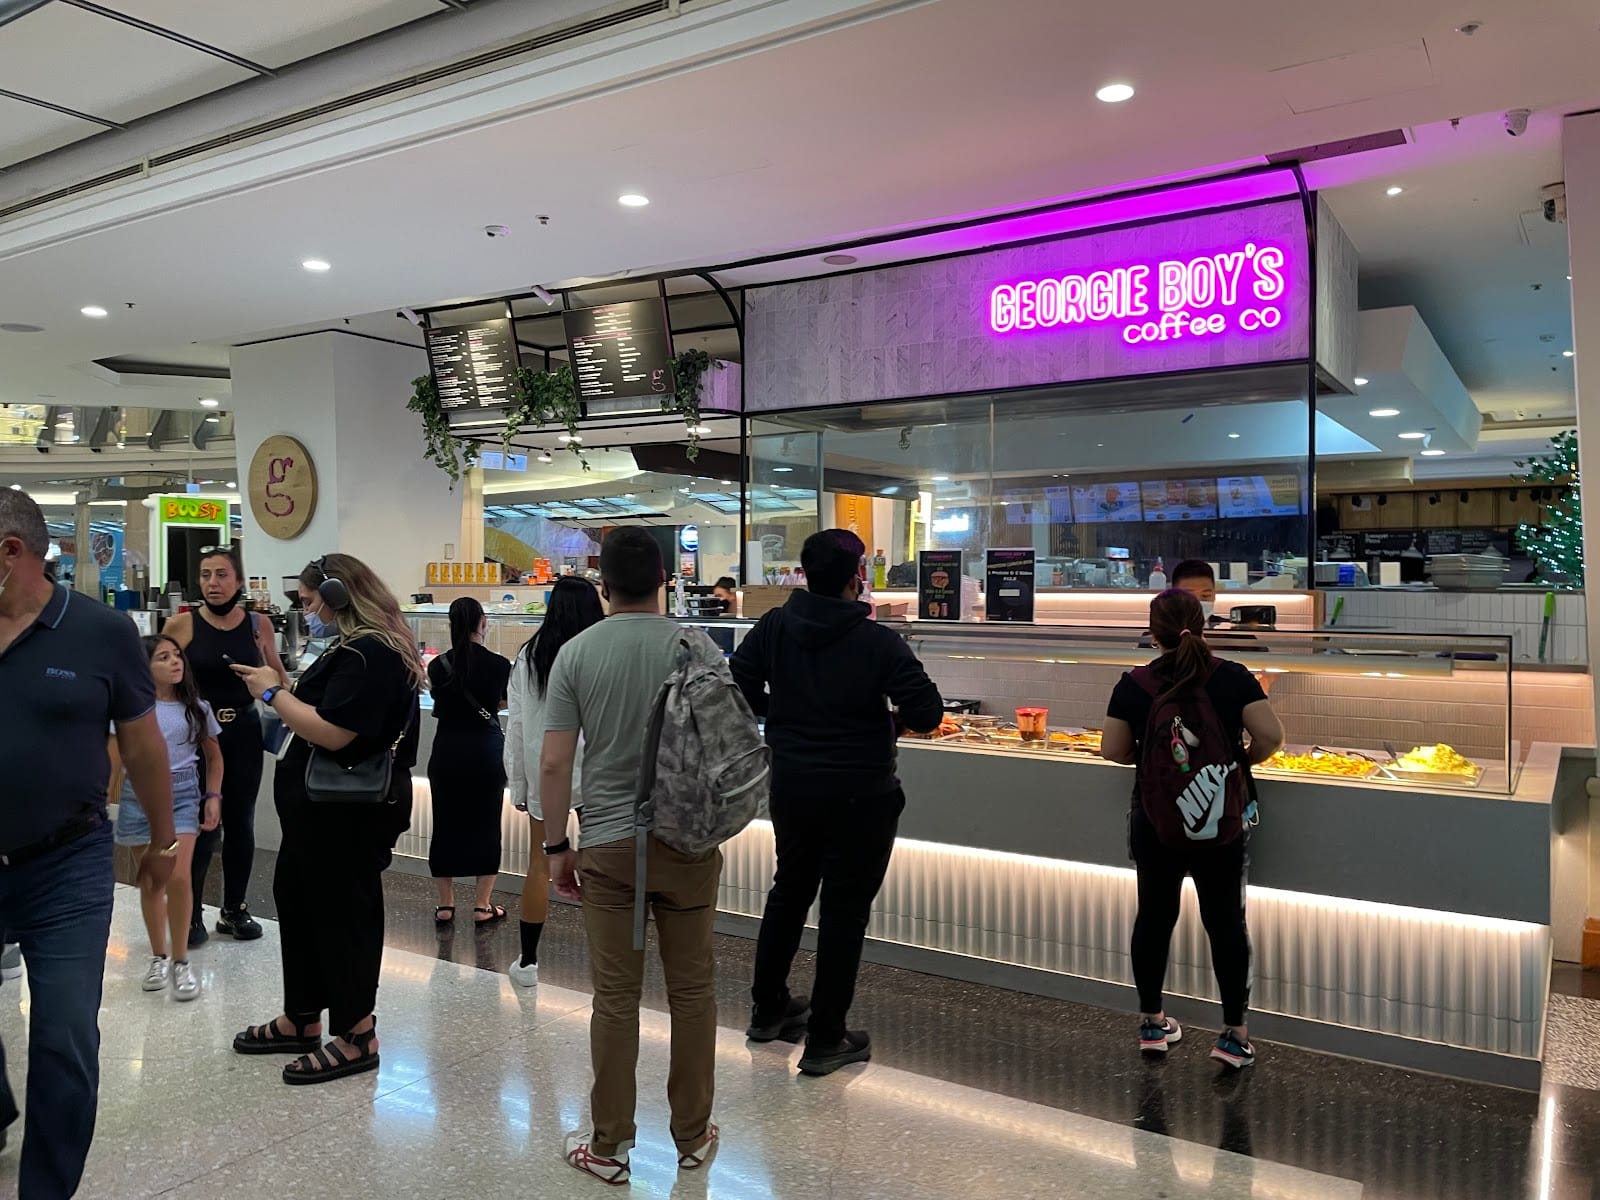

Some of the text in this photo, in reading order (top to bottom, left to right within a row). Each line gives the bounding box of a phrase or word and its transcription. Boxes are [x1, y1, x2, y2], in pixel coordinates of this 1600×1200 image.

[990, 242, 1285, 333] GEORGIE BOY'S
[1123, 306, 1281, 344] coffee co
[165, 500, 222, 520] BOOST
[264, 456, 295, 517] g
[1175, 763, 1229, 829] NIKE
